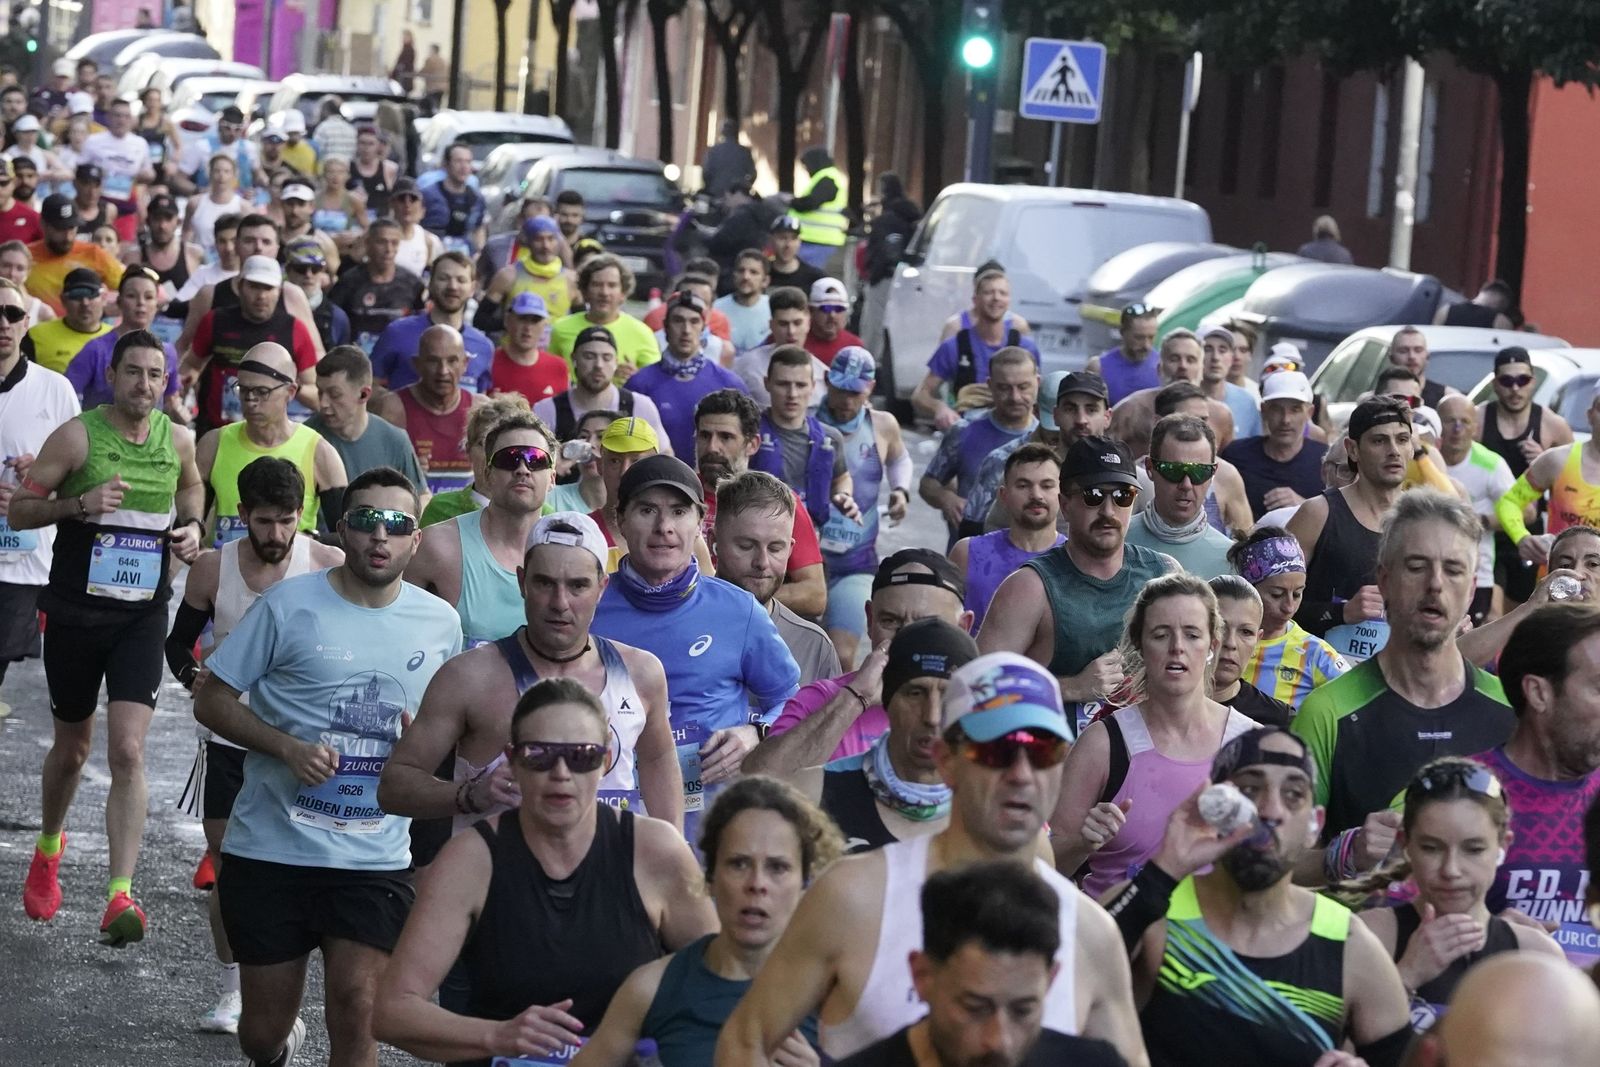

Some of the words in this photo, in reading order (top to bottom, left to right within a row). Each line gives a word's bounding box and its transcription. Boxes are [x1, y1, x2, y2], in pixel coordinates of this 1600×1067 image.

[120, 537, 157, 550] ZURICH
[118, 557, 140, 568] 6445
[112, 570, 141, 585] JAVI
[1355, 627, 1378, 638] 7000
[1349, 640, 1378, 656] REY
[337, 784, 364, 796] 9626
[1505, 869, 1562, 900] C.D.
